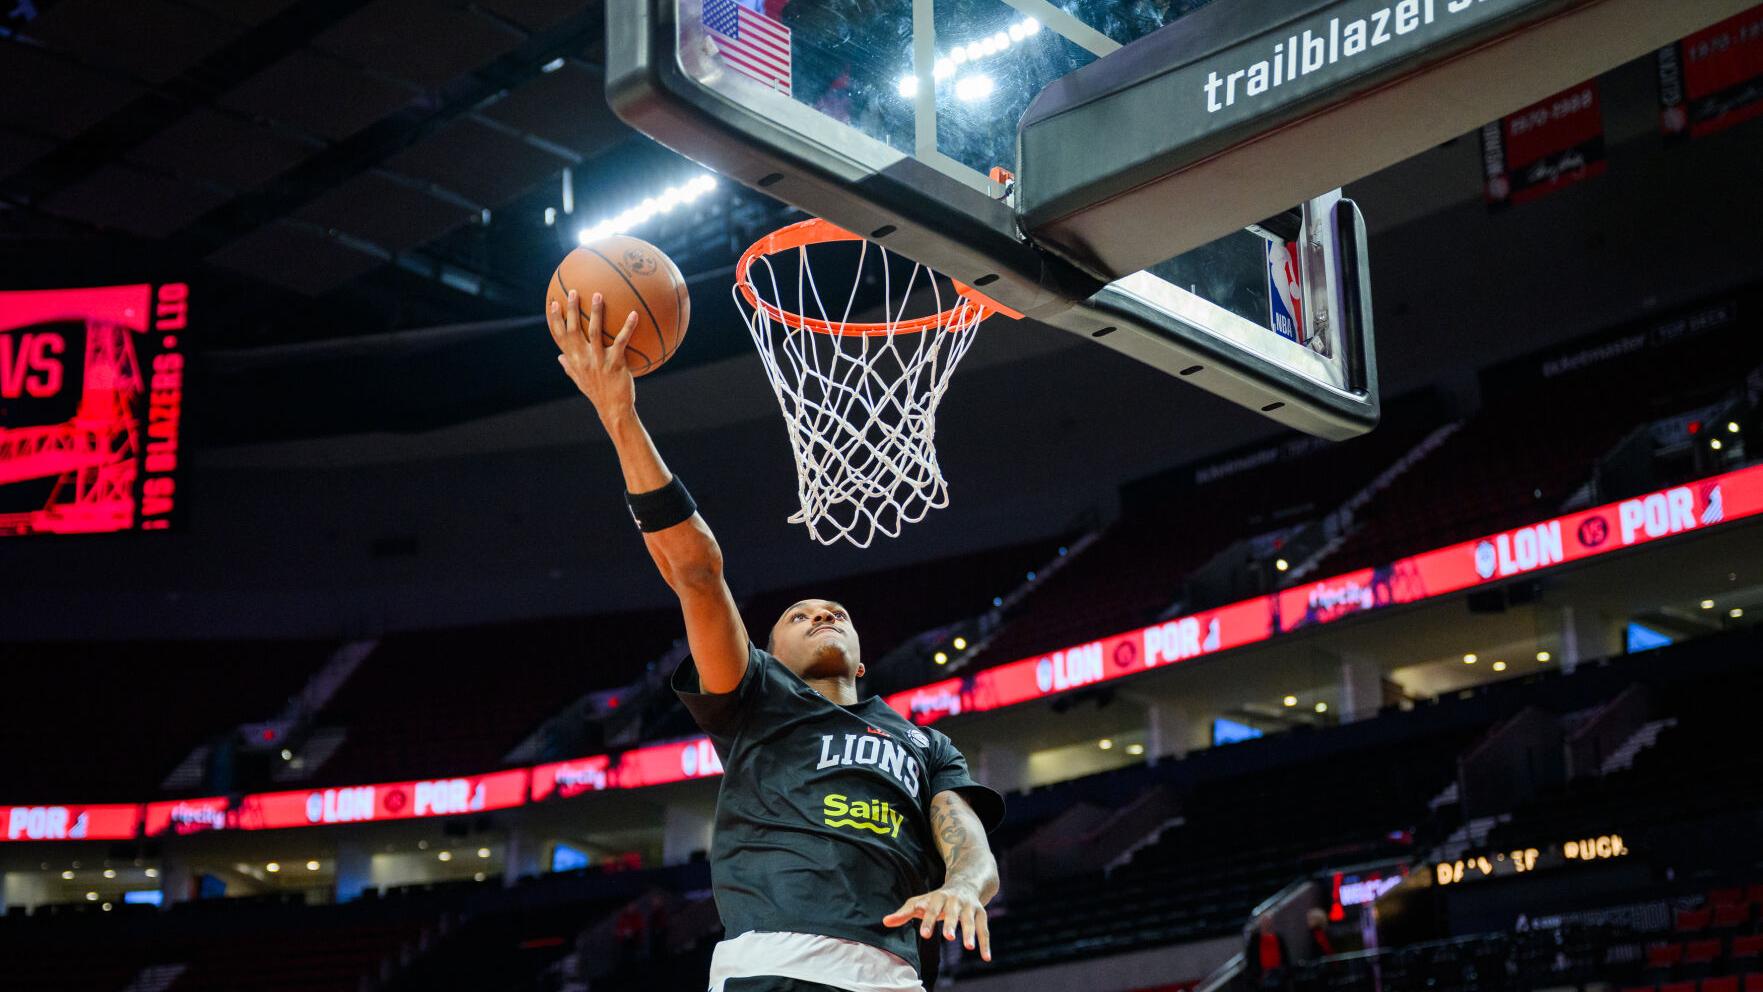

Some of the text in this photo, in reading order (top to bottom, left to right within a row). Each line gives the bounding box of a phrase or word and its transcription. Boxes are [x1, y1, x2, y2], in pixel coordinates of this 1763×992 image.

[1275, 312, 1293, 337] NBA
[0, 332, 65, 399] VS
[145, 352, 185, 473] BLAZERS
[1498, 520, 1563, 577] LON
[1619, 486, 1697, 545] POR
[1054, 641, 1104, 690] LON
[1144, 617, 1200, 668] POR
[816, 734, 920, 798] LIONS
[9, 806, 69, 840] POR
[323, 786, 375, 823] LON
[414, 779, 471, 817] POR
[823, 793, 904, 839] Saily
